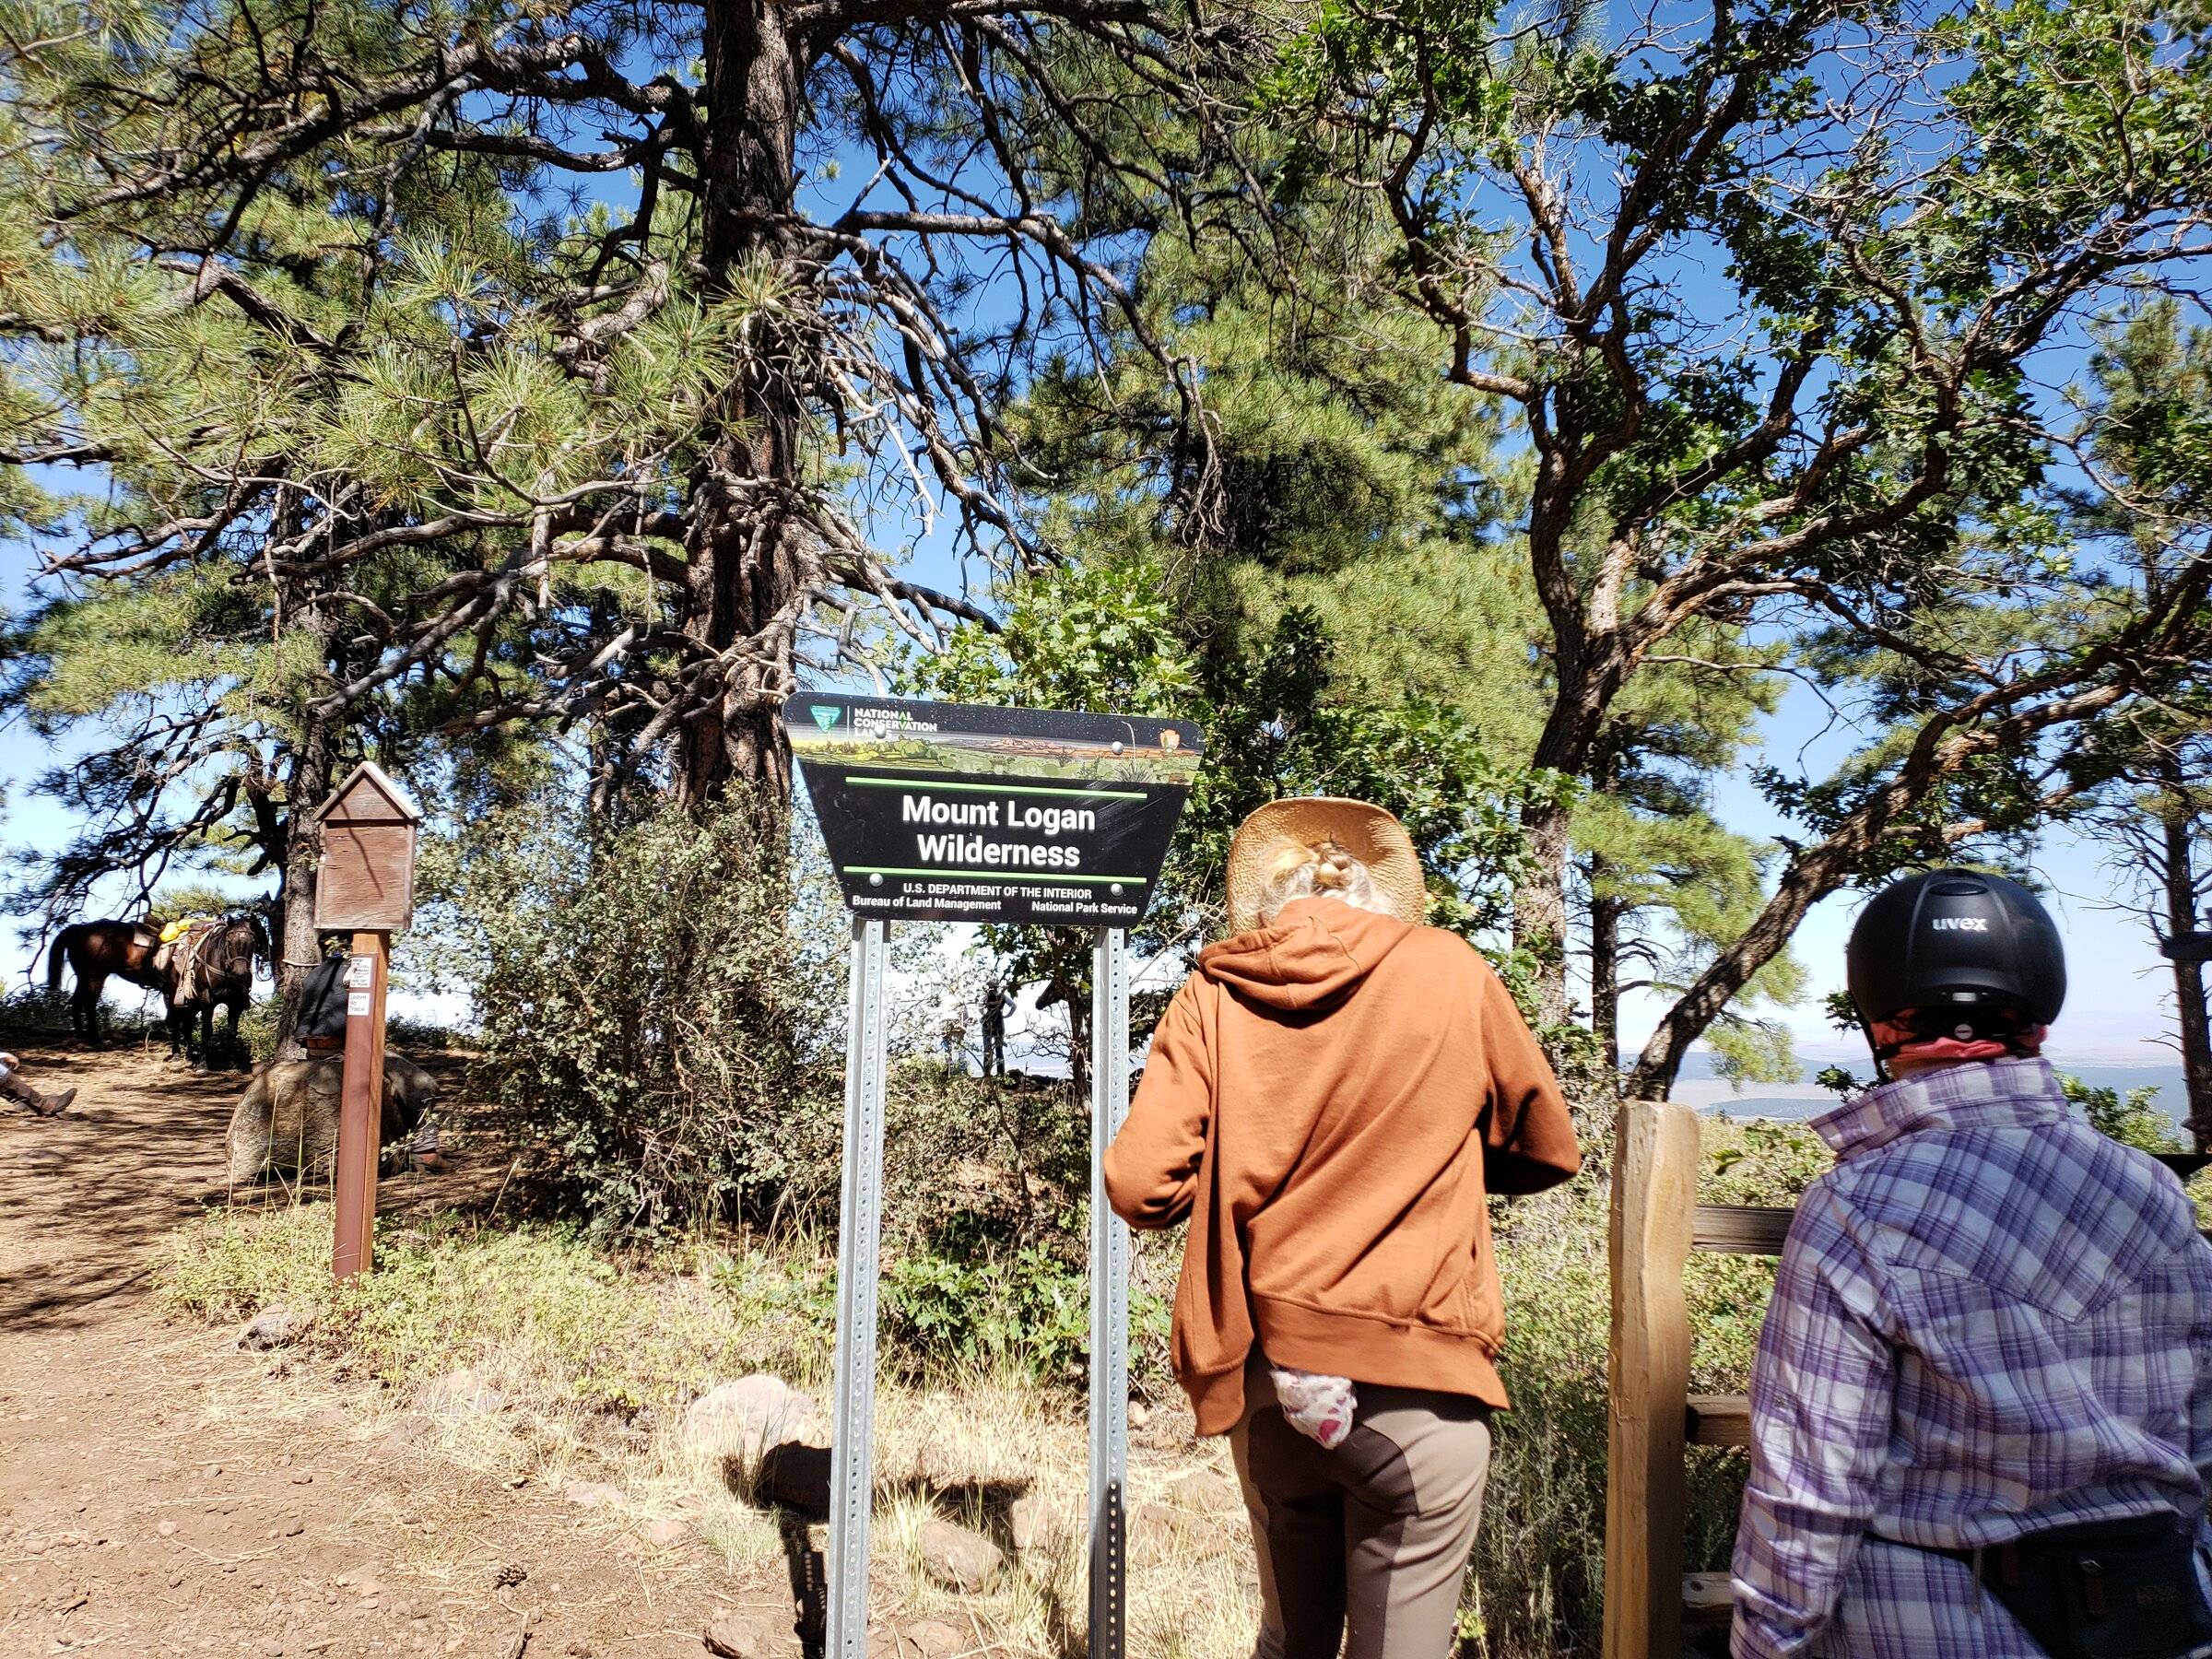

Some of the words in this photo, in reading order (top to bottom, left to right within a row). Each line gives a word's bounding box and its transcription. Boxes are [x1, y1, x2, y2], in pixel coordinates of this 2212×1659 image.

[853, 707, 913, 721] NATIONAL
[853, 718, 937, 732] CONSERVATION
[902, 794, 999, 826] Mount
[1007, 800, 1096, 835] Logan
[917, 833, 1080, 867] Wilderness
[903, 883, 925, 893] U.S.
[928, 884, 1002, 896] DEPARTMENT
[1004, 886, 1018, 897] OF
[1020, 887, 1041, 898] THE
[1043, 888, 1092, 900] INTERIOR
[853, 895, 890, 907] Bureau
[892, 896, 904, 907] of
[906, 897, 933, 908] Land
[934, 898, 1002, 911] Management
[1031, 900, 1074, 912] National
[1076, 902, 1099, 913] Park
[1100, 903, 1138, 915] Service
[1933, 918, 1987, 932] uvex
